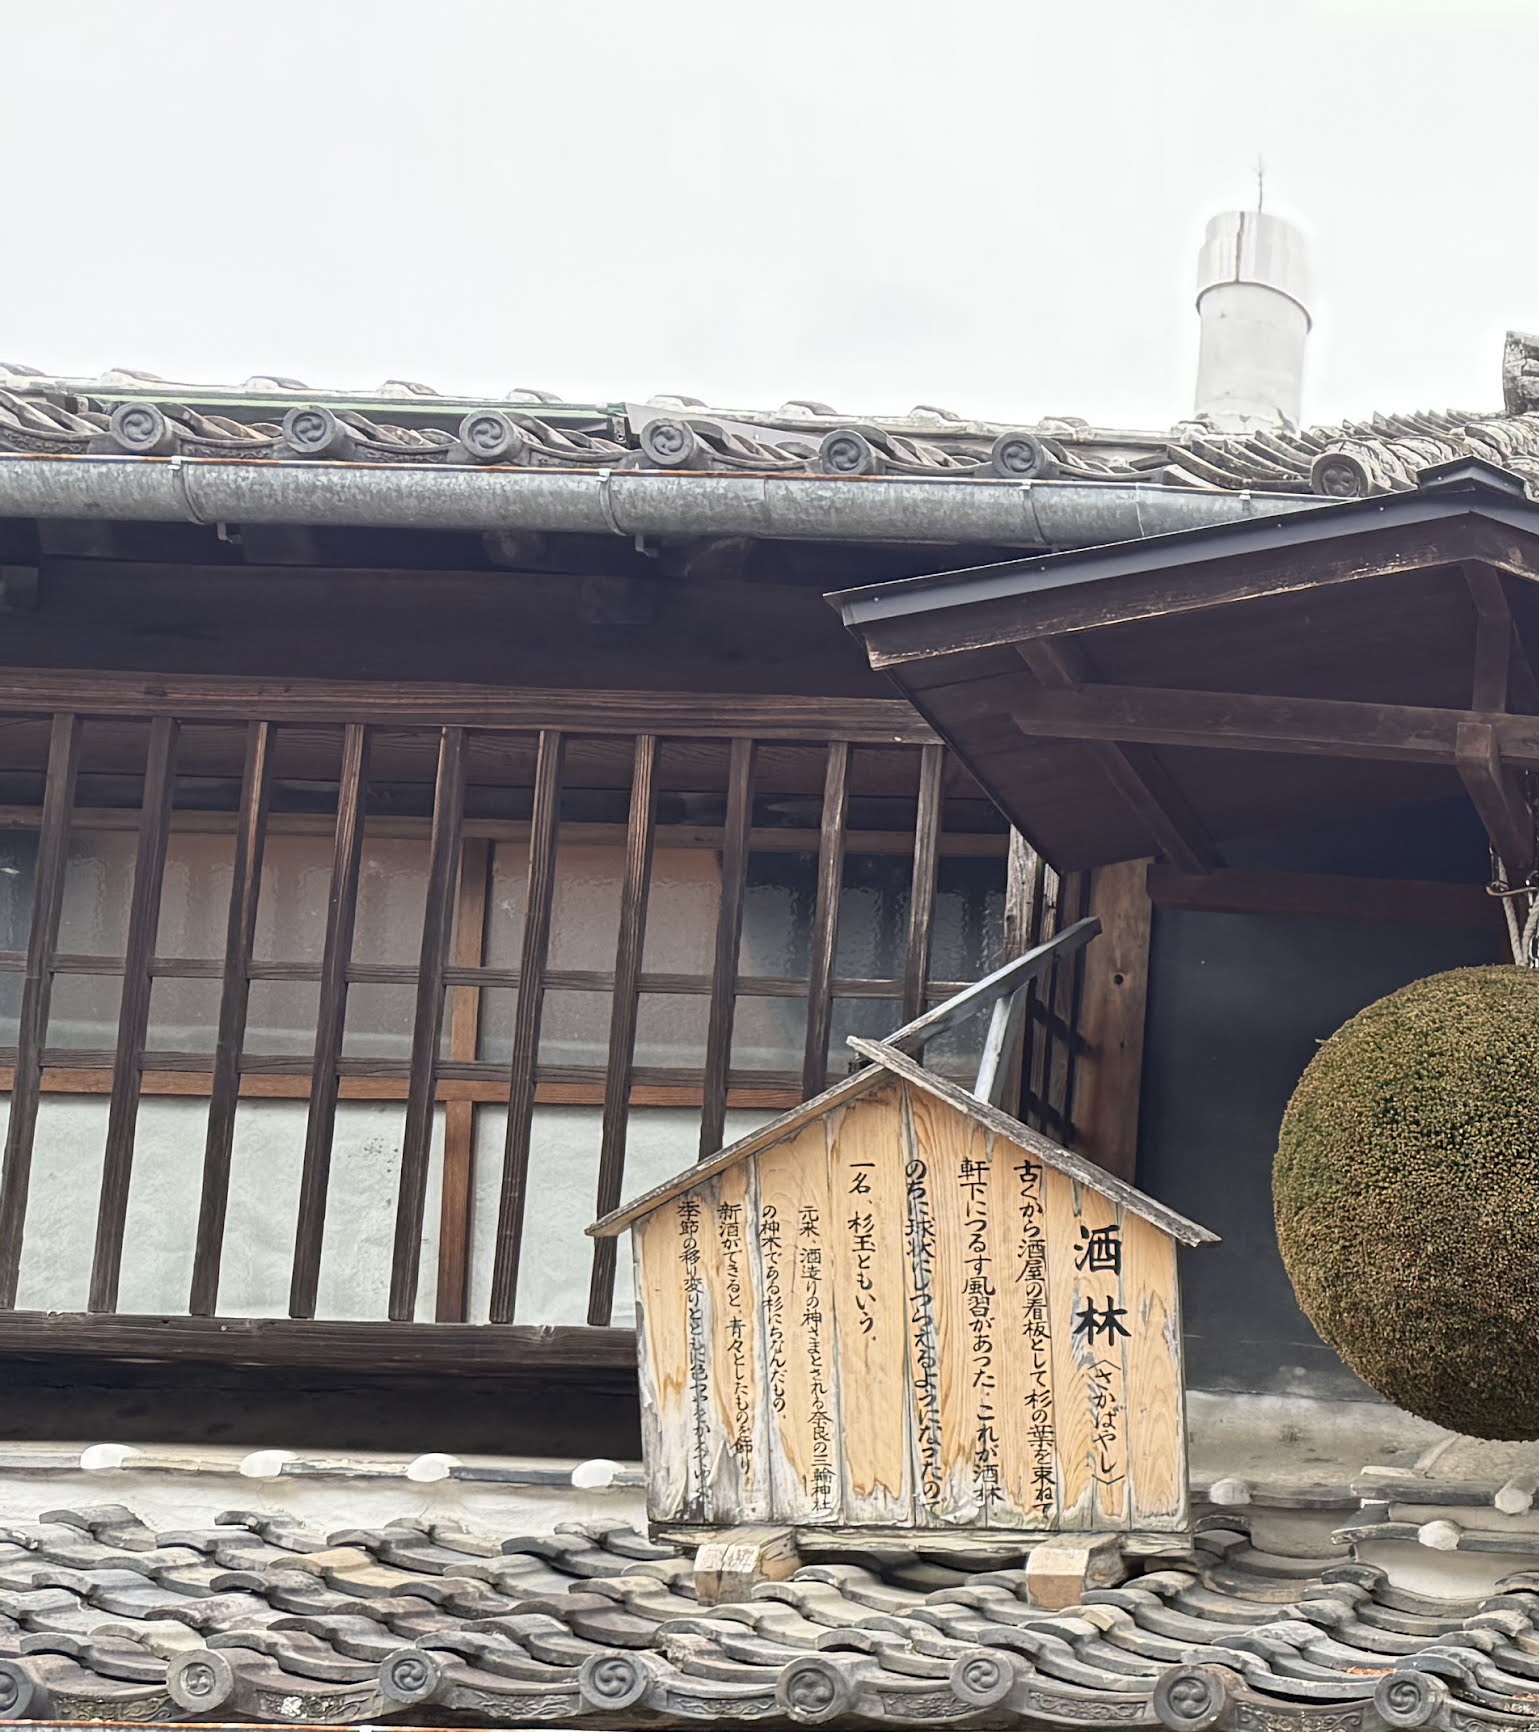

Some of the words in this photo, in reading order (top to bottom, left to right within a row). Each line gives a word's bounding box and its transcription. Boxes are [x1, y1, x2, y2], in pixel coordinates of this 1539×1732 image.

[1014, 1160, 1056, 1516] 古くから酒屋の看板として杉の葉を束ねて
[1073, 1225, 1132, 1347] 酒林
